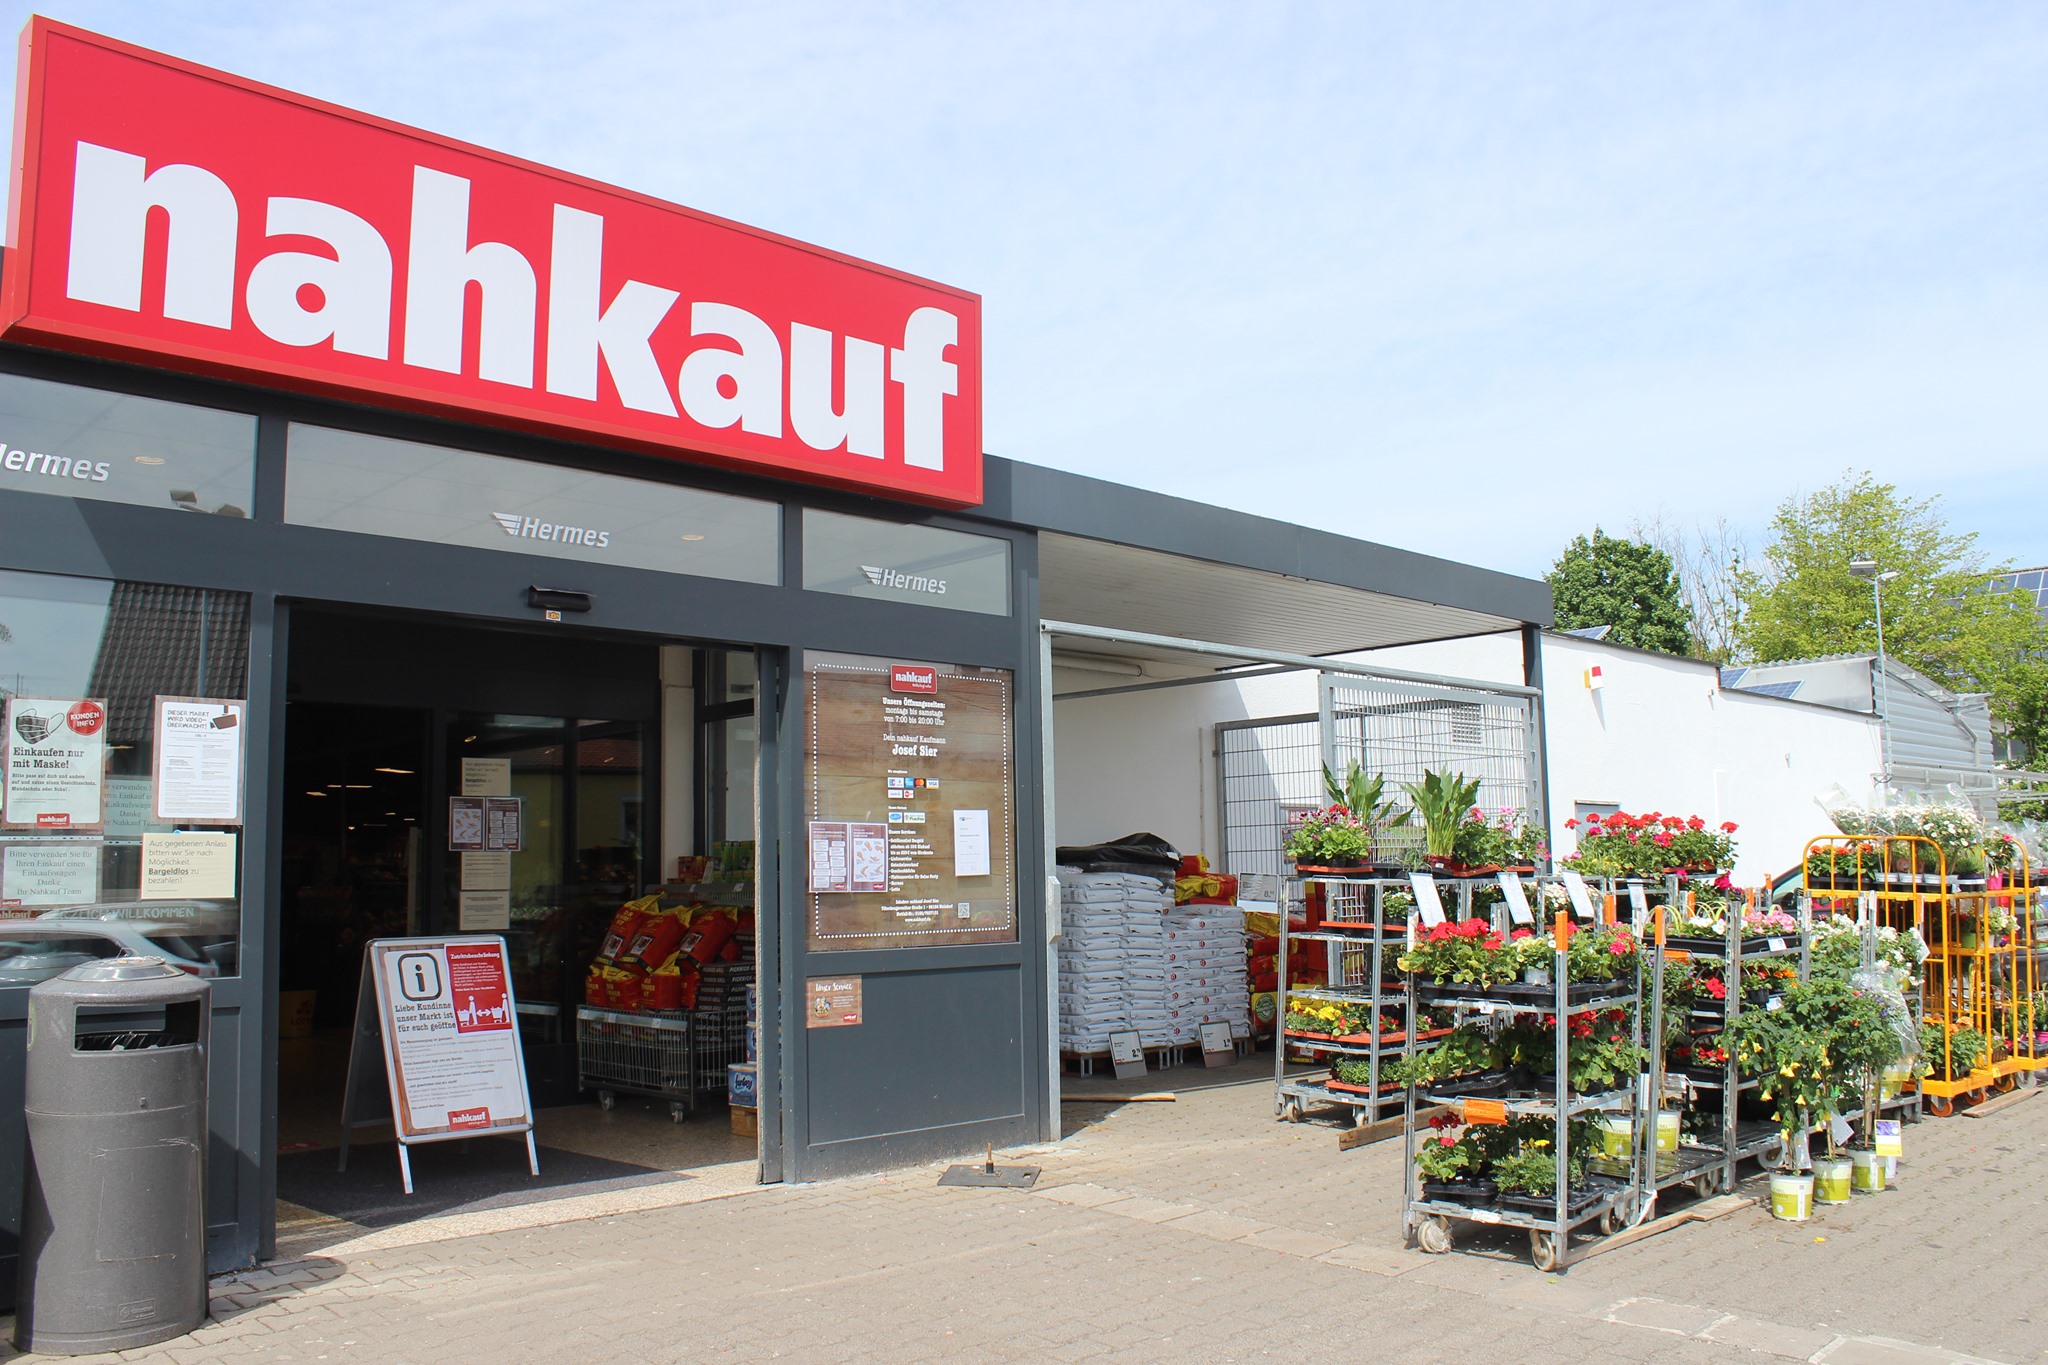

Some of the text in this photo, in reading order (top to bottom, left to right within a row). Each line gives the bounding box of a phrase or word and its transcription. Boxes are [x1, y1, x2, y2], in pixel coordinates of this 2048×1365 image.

[66, 140, 958, 473] nahkauf
[521, 516, 610, 548] Hermes
[882, 568, 946, 594] Hermes
[895, 672, 932, 684] nahkauf
[882, 697, 946, 708] Unsere Öffnungszeiten:
[70, 712, 100, 720] KUNDEN
[886, 707, 908, 716] montags
[918, 710, 943, 718] samstags
[918, 717, 933, 725] 20:00
[896, 734, 918, 742] nahkauf
[920, 735, 946, 744] Kaufmann
[13, 747, 65, 757] Einkaufen
[892, 744, 938, 757] Josef Sier
[12, 759, 69, 769] mit Maske!
[106, 800, 152, 809] Einkaufswage
[165, 840, 203, 848] gegebenen
[149, 868, 189, 876] Bargeldlos
[114, 908, 194, 919] WILLKOMMEN
[816, 982, 853, 992] Unser Service
[417, 1002, 451, 1011] Kundinne
[396, 1014, 417, 1022] unser
[419, 1012, 441, 1020] Markt
[398, 1022, 456, 1032] für euch geöffne
[453, 1112, 486, 1123] nahkauf
